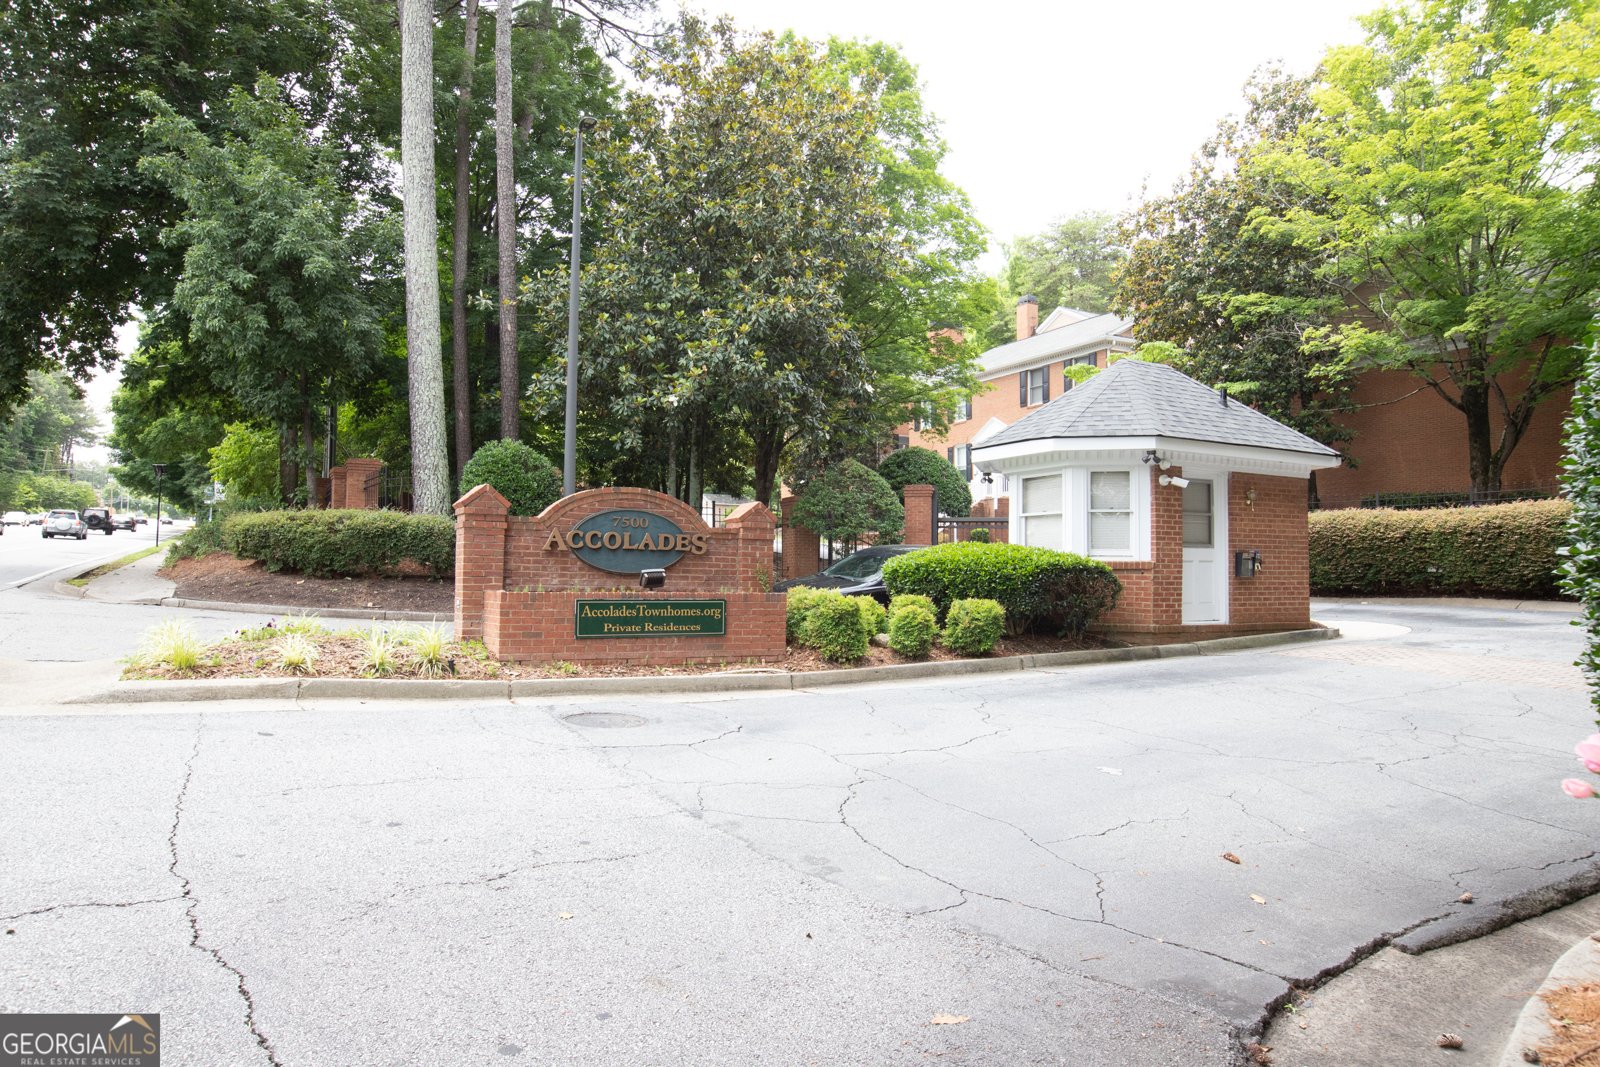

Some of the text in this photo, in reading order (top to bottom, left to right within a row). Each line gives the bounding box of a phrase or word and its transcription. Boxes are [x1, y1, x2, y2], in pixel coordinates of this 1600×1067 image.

[613, 516, 649, 528] 7500
[542, 527, 709, 555] ACCOLADES
[581, 604, 722, 619] AccoladesTownhomes.org
[603, 622, 701, 632] Private Residences
